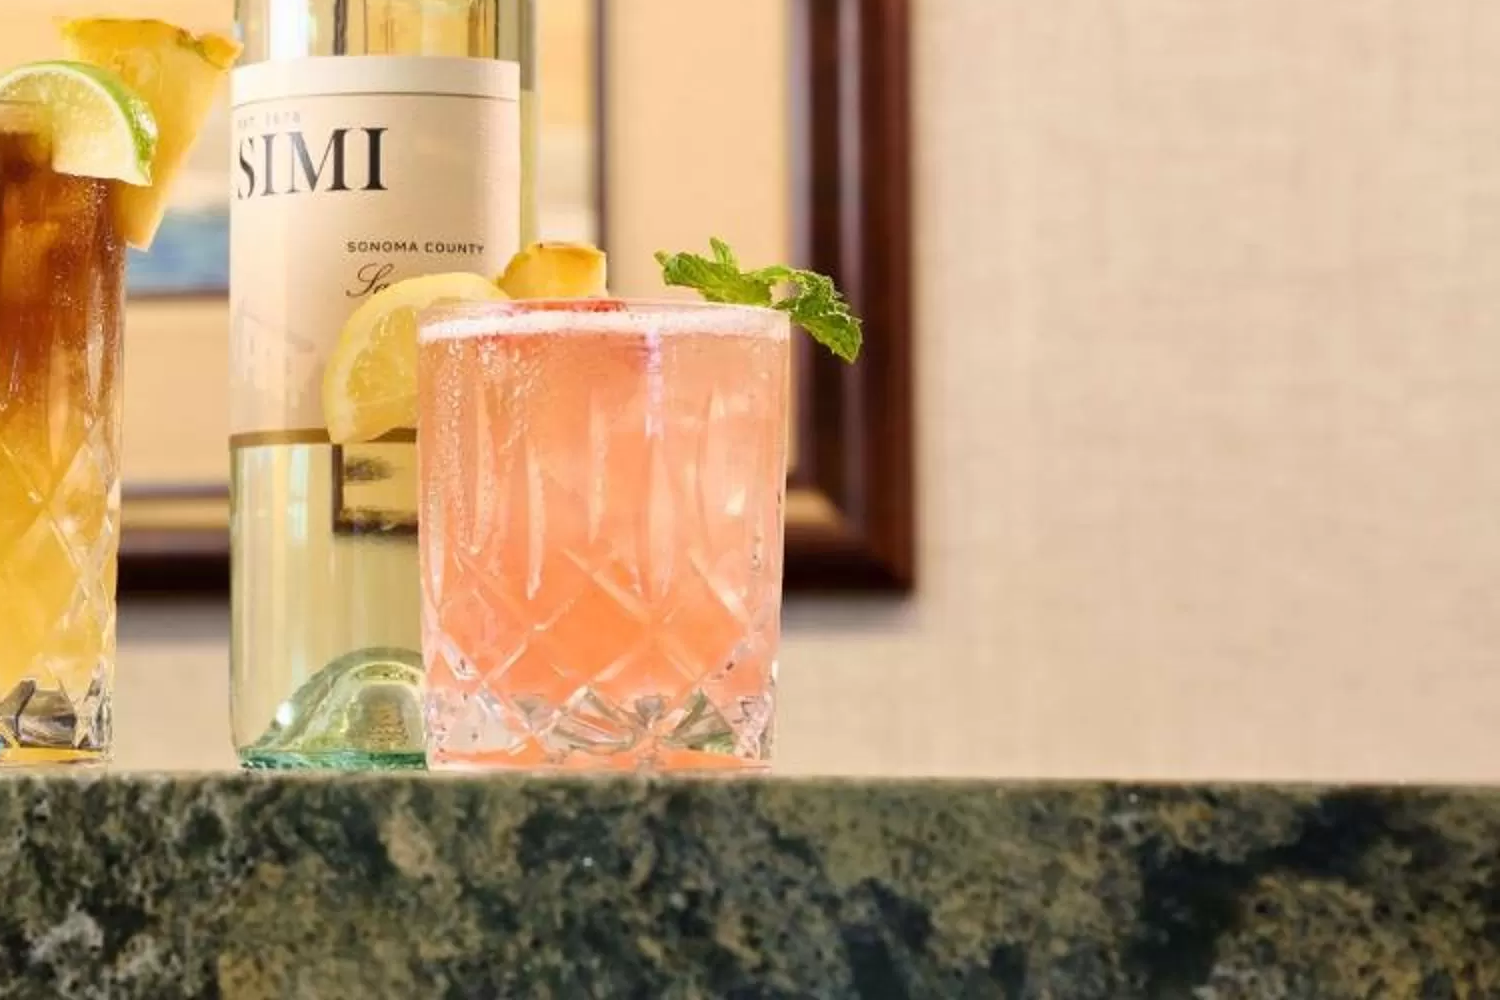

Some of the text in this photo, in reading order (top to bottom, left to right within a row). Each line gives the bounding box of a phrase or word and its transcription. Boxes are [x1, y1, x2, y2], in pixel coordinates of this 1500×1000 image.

[237, 127, 389, 200] SIMI
[347, 240, 485, 255] SONOMA COUNTY
